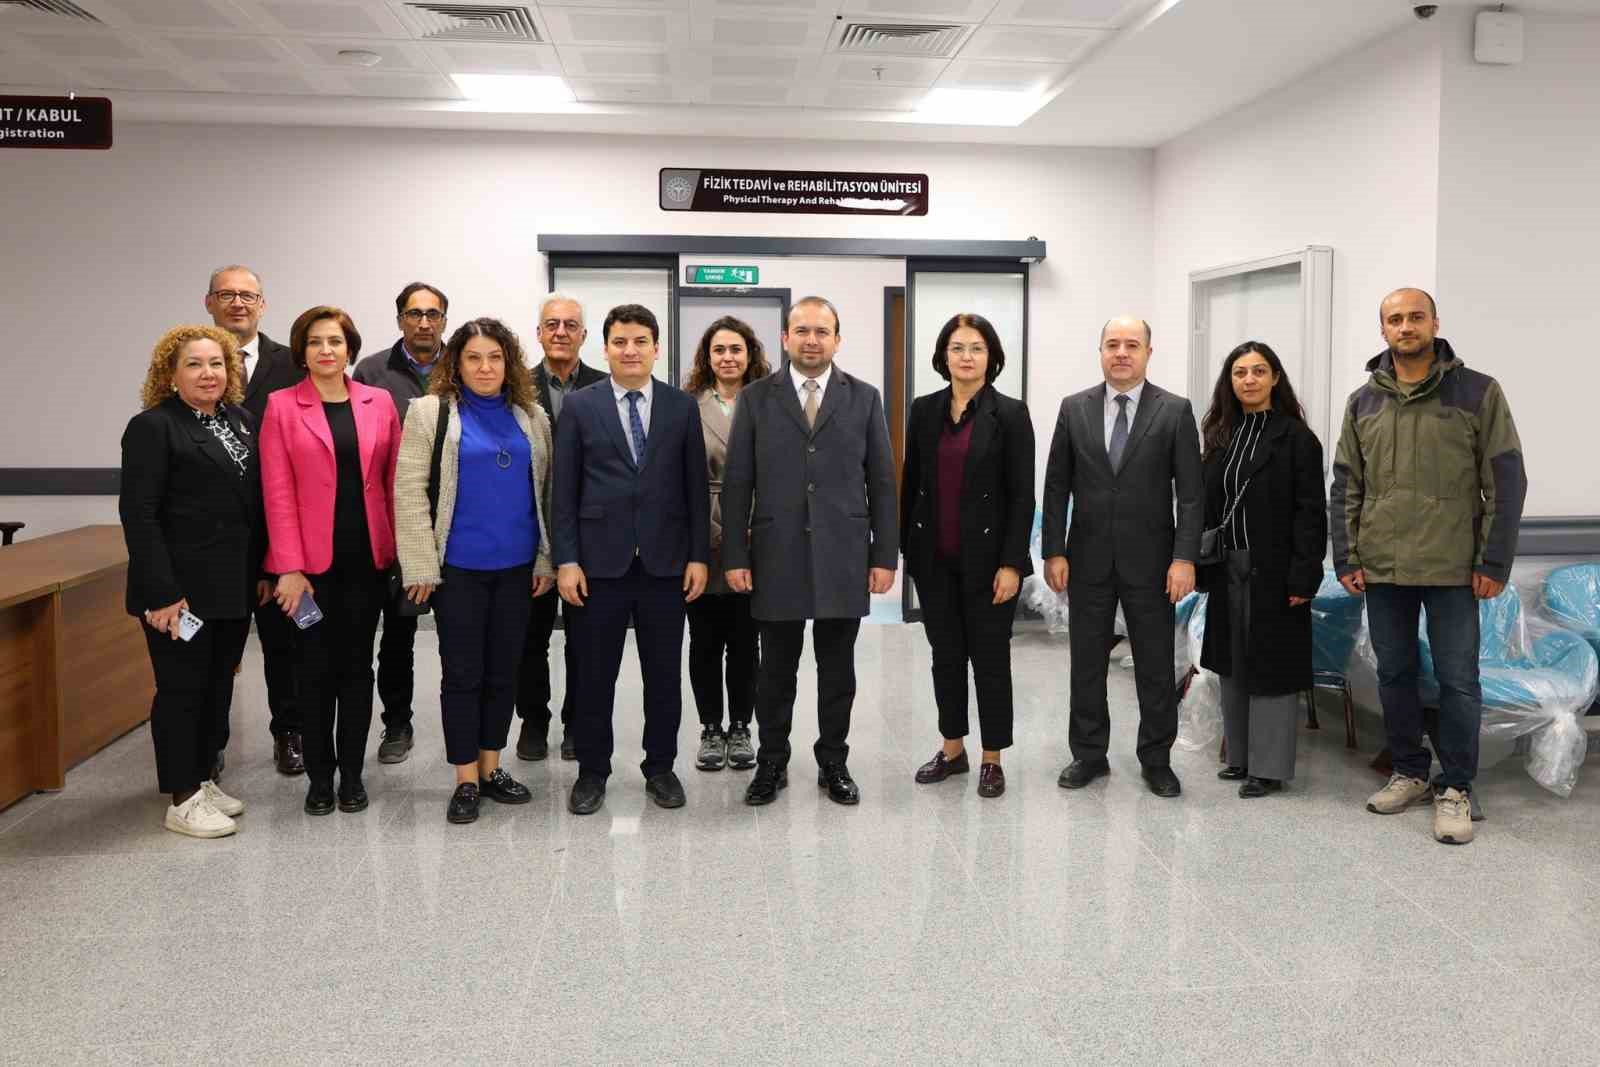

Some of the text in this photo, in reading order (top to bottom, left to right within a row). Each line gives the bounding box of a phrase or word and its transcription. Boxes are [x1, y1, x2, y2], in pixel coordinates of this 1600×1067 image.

[16, 108, 23, 122] /
[26, 108, 82, 122] KABUL
[703, 175, 922, 194] FİZİK TEDAVİ ve REHABİLİTASYON ÜNİTESİ
[723, 194, 760, 205] Physical
[761, 195, 797, 206] Therapy
[799, 196, 817, 205] And
